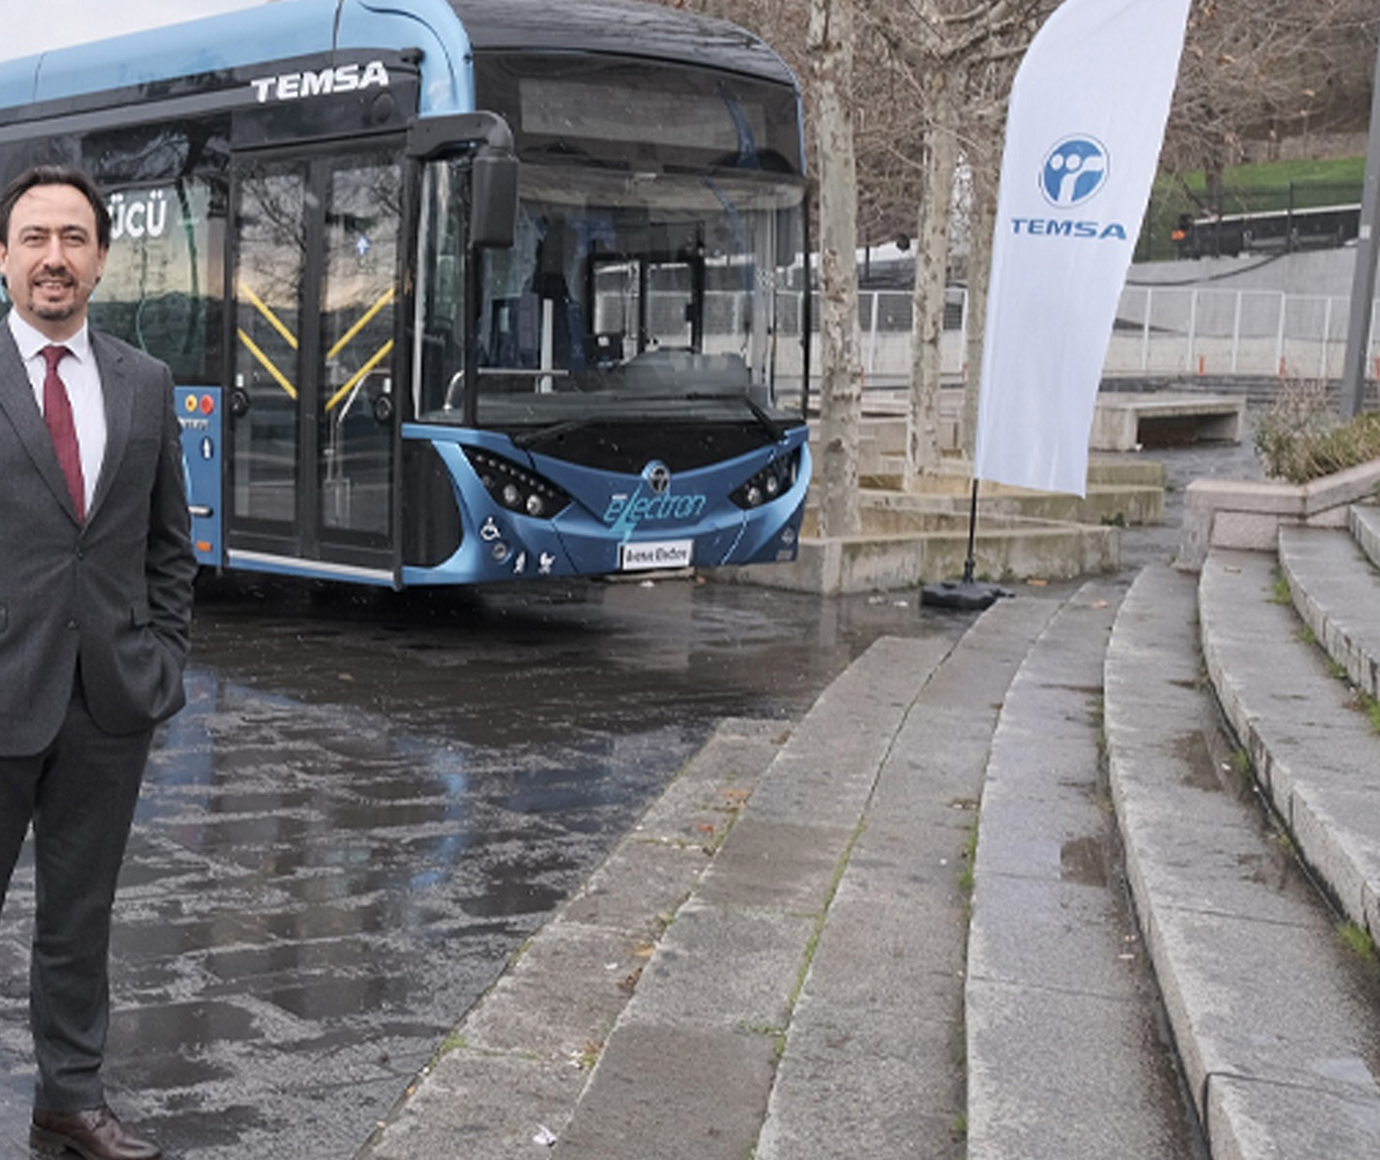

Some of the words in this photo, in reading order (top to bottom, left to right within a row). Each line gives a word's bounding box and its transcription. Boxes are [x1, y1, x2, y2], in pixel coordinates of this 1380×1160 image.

[251, 60, 389, 103] TEMSA
[107, 189, 167, 240] ÜCÜ
[1011, 218, 1127, 240] TEMSA
[603, 482, 707, 532] electron
